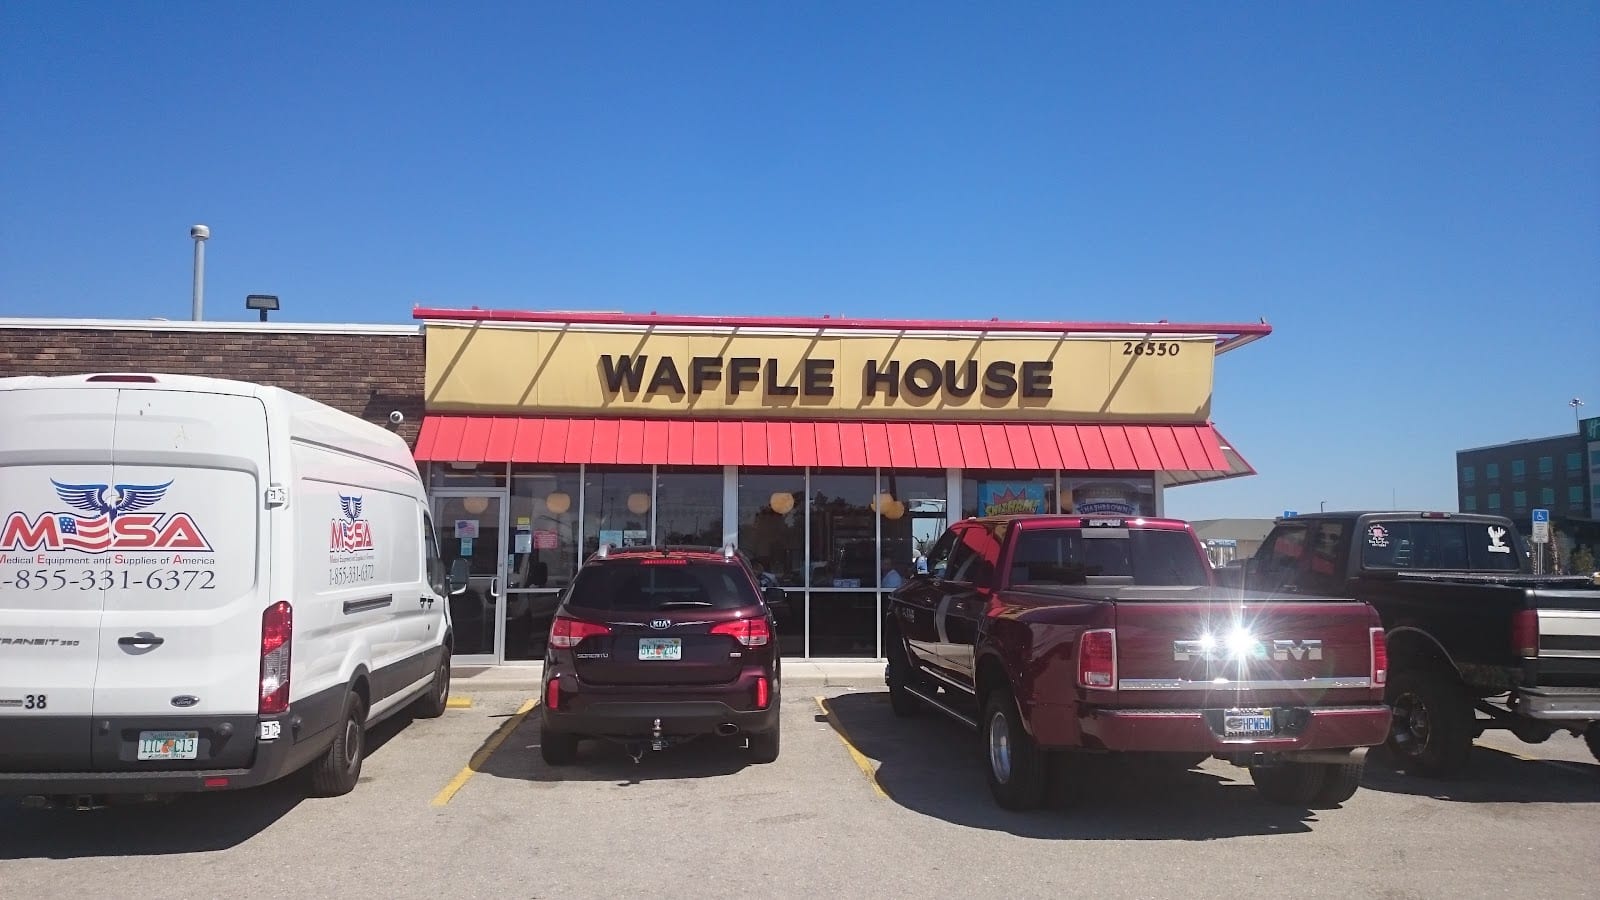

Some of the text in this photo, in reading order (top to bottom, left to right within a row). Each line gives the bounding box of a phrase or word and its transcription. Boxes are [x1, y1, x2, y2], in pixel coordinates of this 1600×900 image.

[1123, 342, 1180, 356] 26550
[599, 355, 1054, 399] WAFFLE HOUSE
[37, 554, 90, 567] Equipment
[93, 556, 111, 565] and
[114, 554, 157, 567] Supplies
[160, 556, 170, 565] of
[172, 554, 215, 565] America
[0, 569, 216, 591] -855-331-6372
[652, 619, 669, 629] KIA
[25, 694, 47, 710] 38
